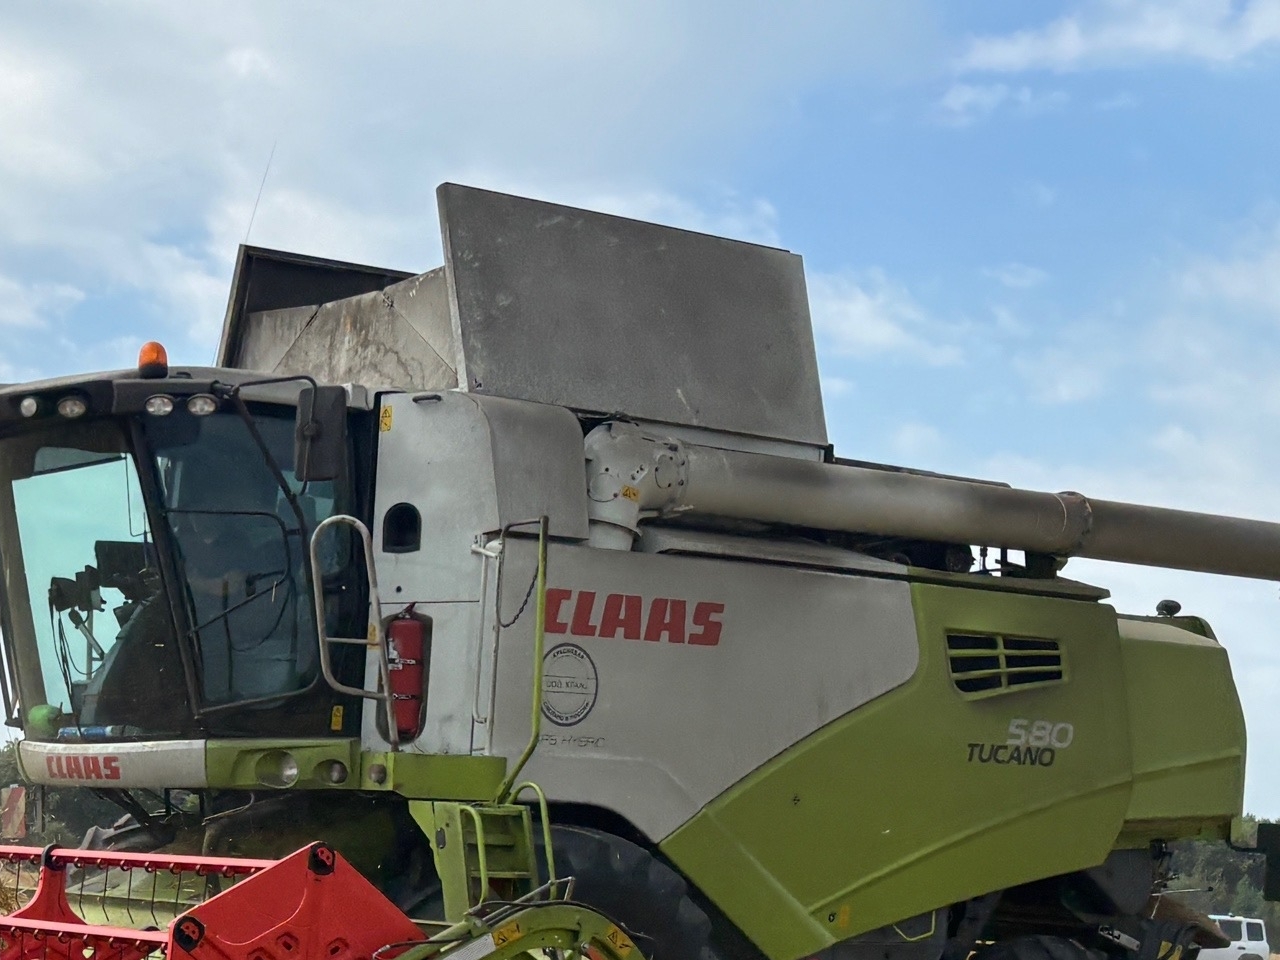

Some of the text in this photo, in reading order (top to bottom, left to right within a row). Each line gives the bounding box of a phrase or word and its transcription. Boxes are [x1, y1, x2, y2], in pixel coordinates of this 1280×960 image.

[544, 588, 724, 646] CLAAS
[1006, 718, 1074, 749] 580
[46, 755, 121, 780] CLAAS
[967, 742, 1056, 767] TUCANO
